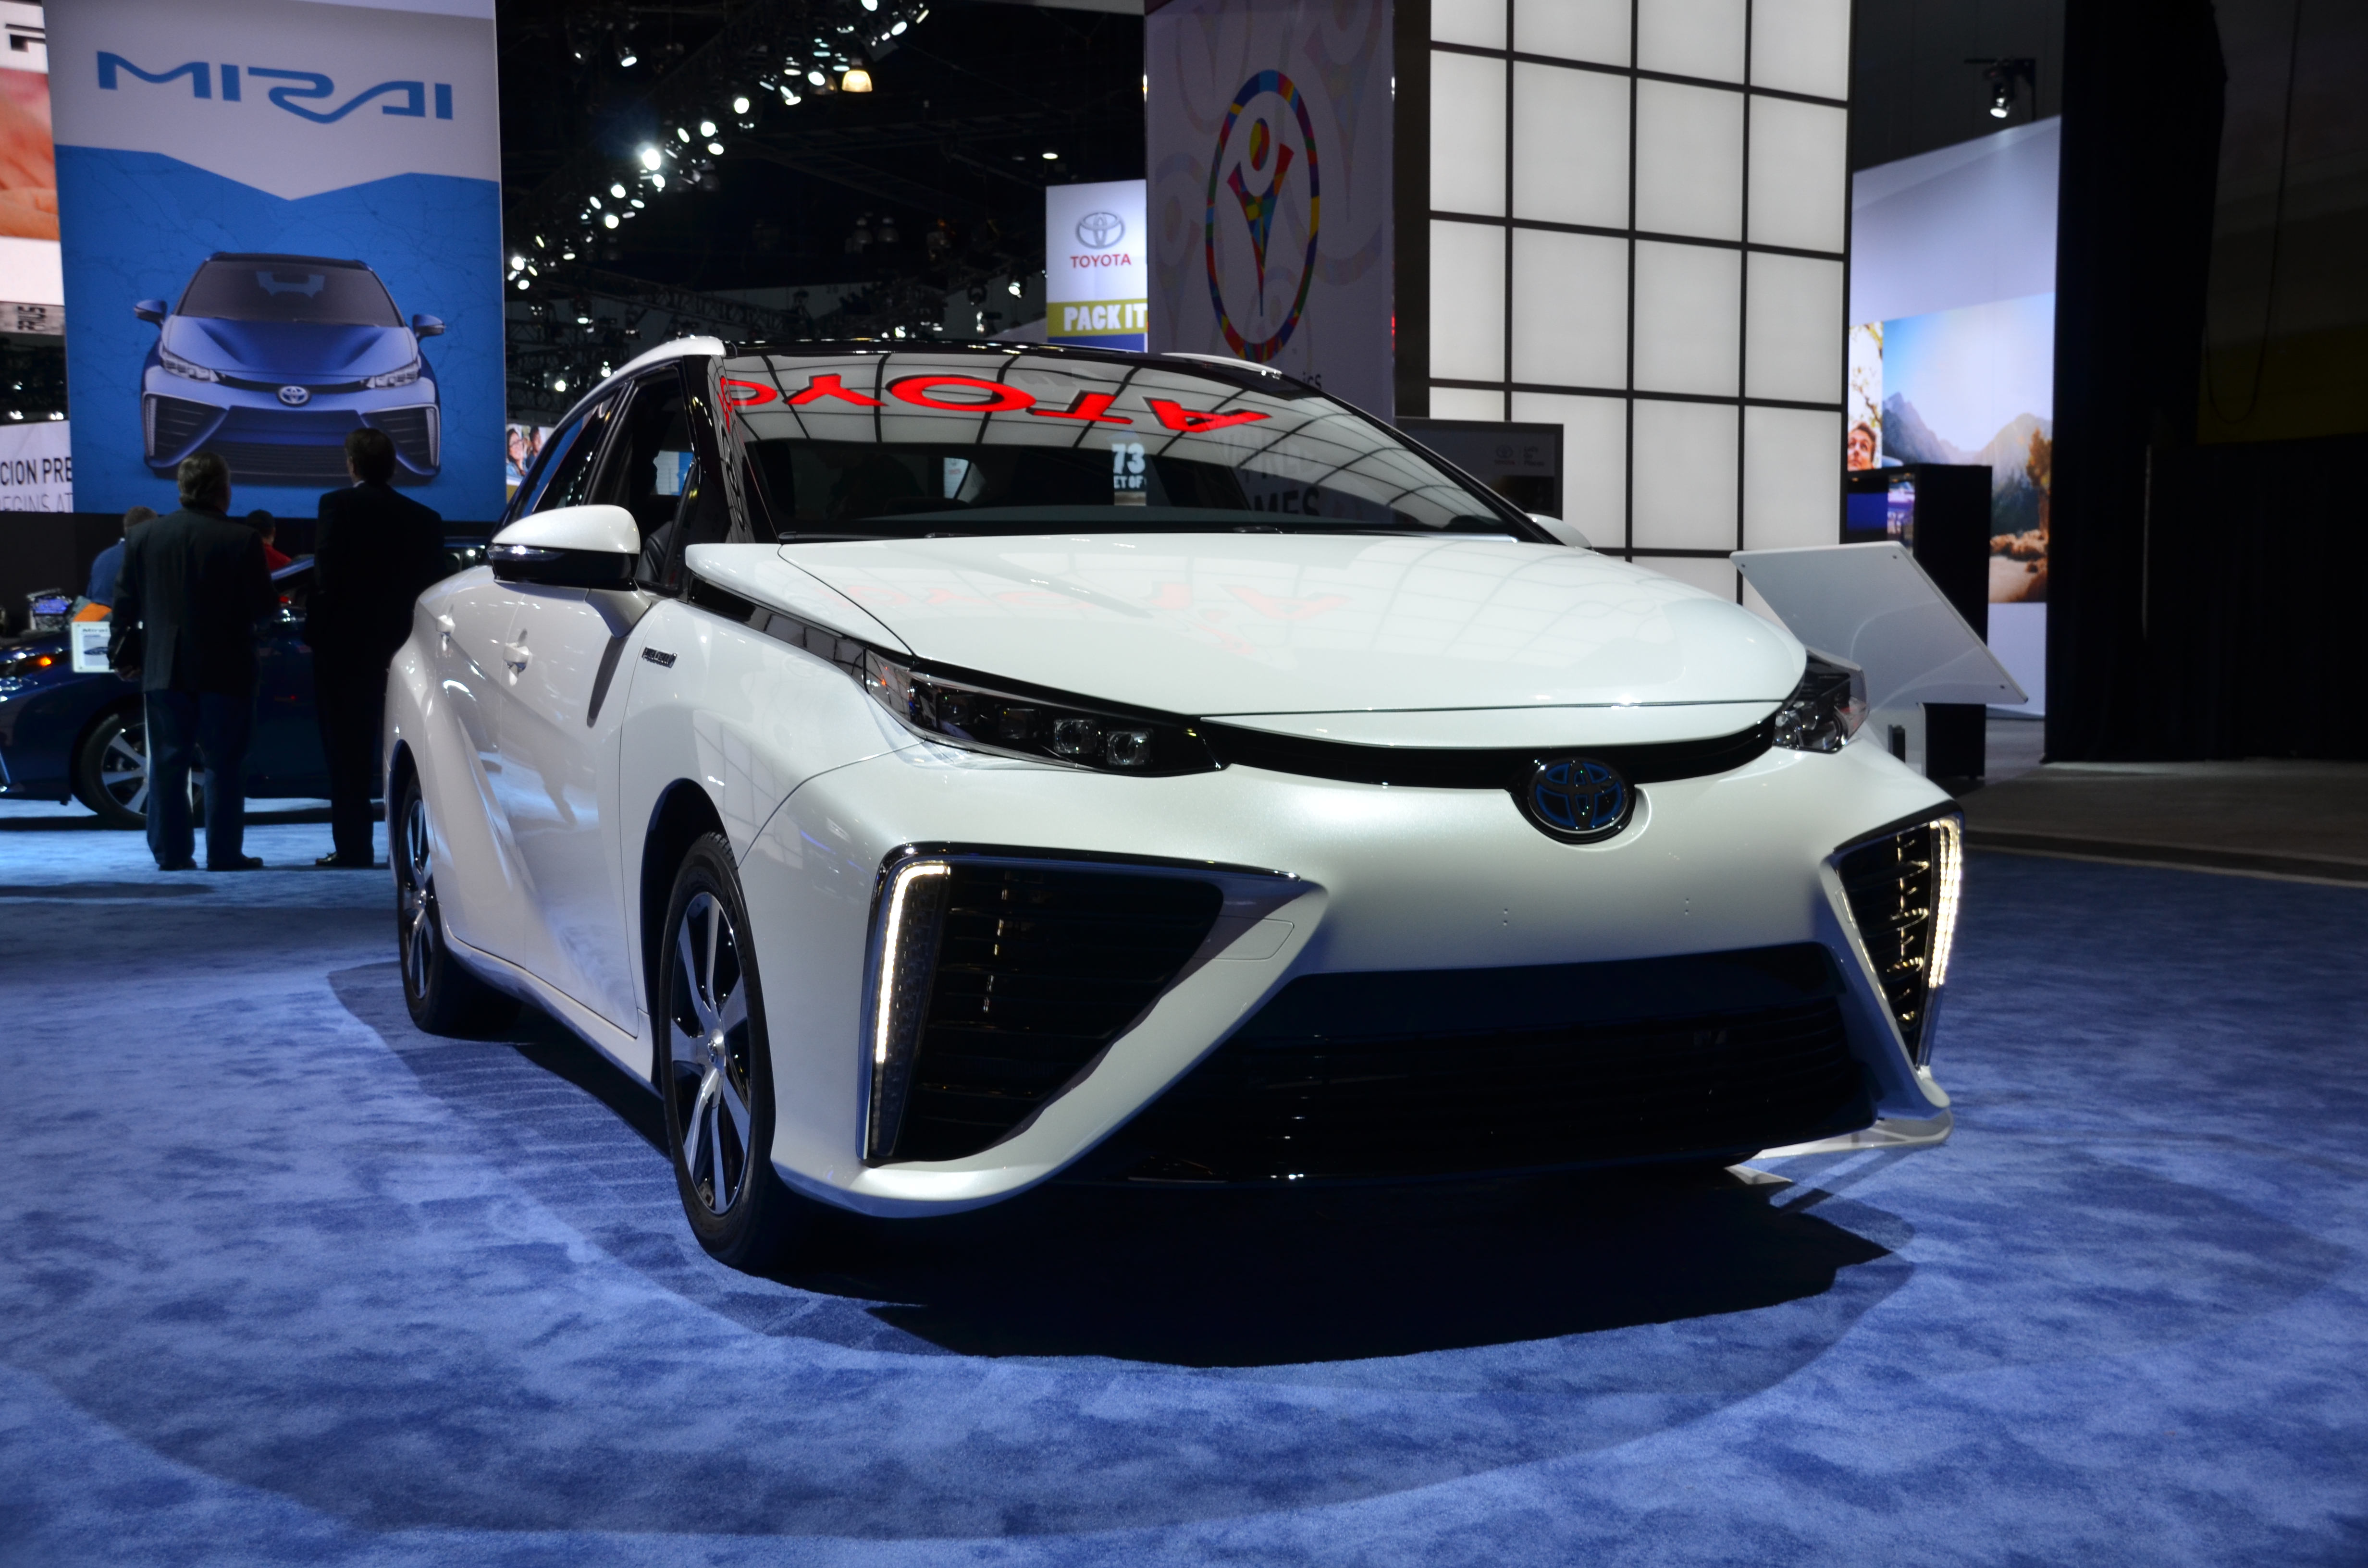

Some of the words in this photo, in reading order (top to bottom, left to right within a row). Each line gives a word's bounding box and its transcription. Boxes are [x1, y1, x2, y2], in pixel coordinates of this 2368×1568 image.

[97, 51, 453, 123] MIRAI
[1070, 254, 1132, 268] TOYOTA
[1063, 304, 1122, 331] PACK
[1125, 303, 1147, 329] IT
[1111, 442, 1146, 475] 73
[0, 459, 38, 486] CION
[1128, 475, 1144, 489] OF
[0, 493, 51, 512] EGINS
